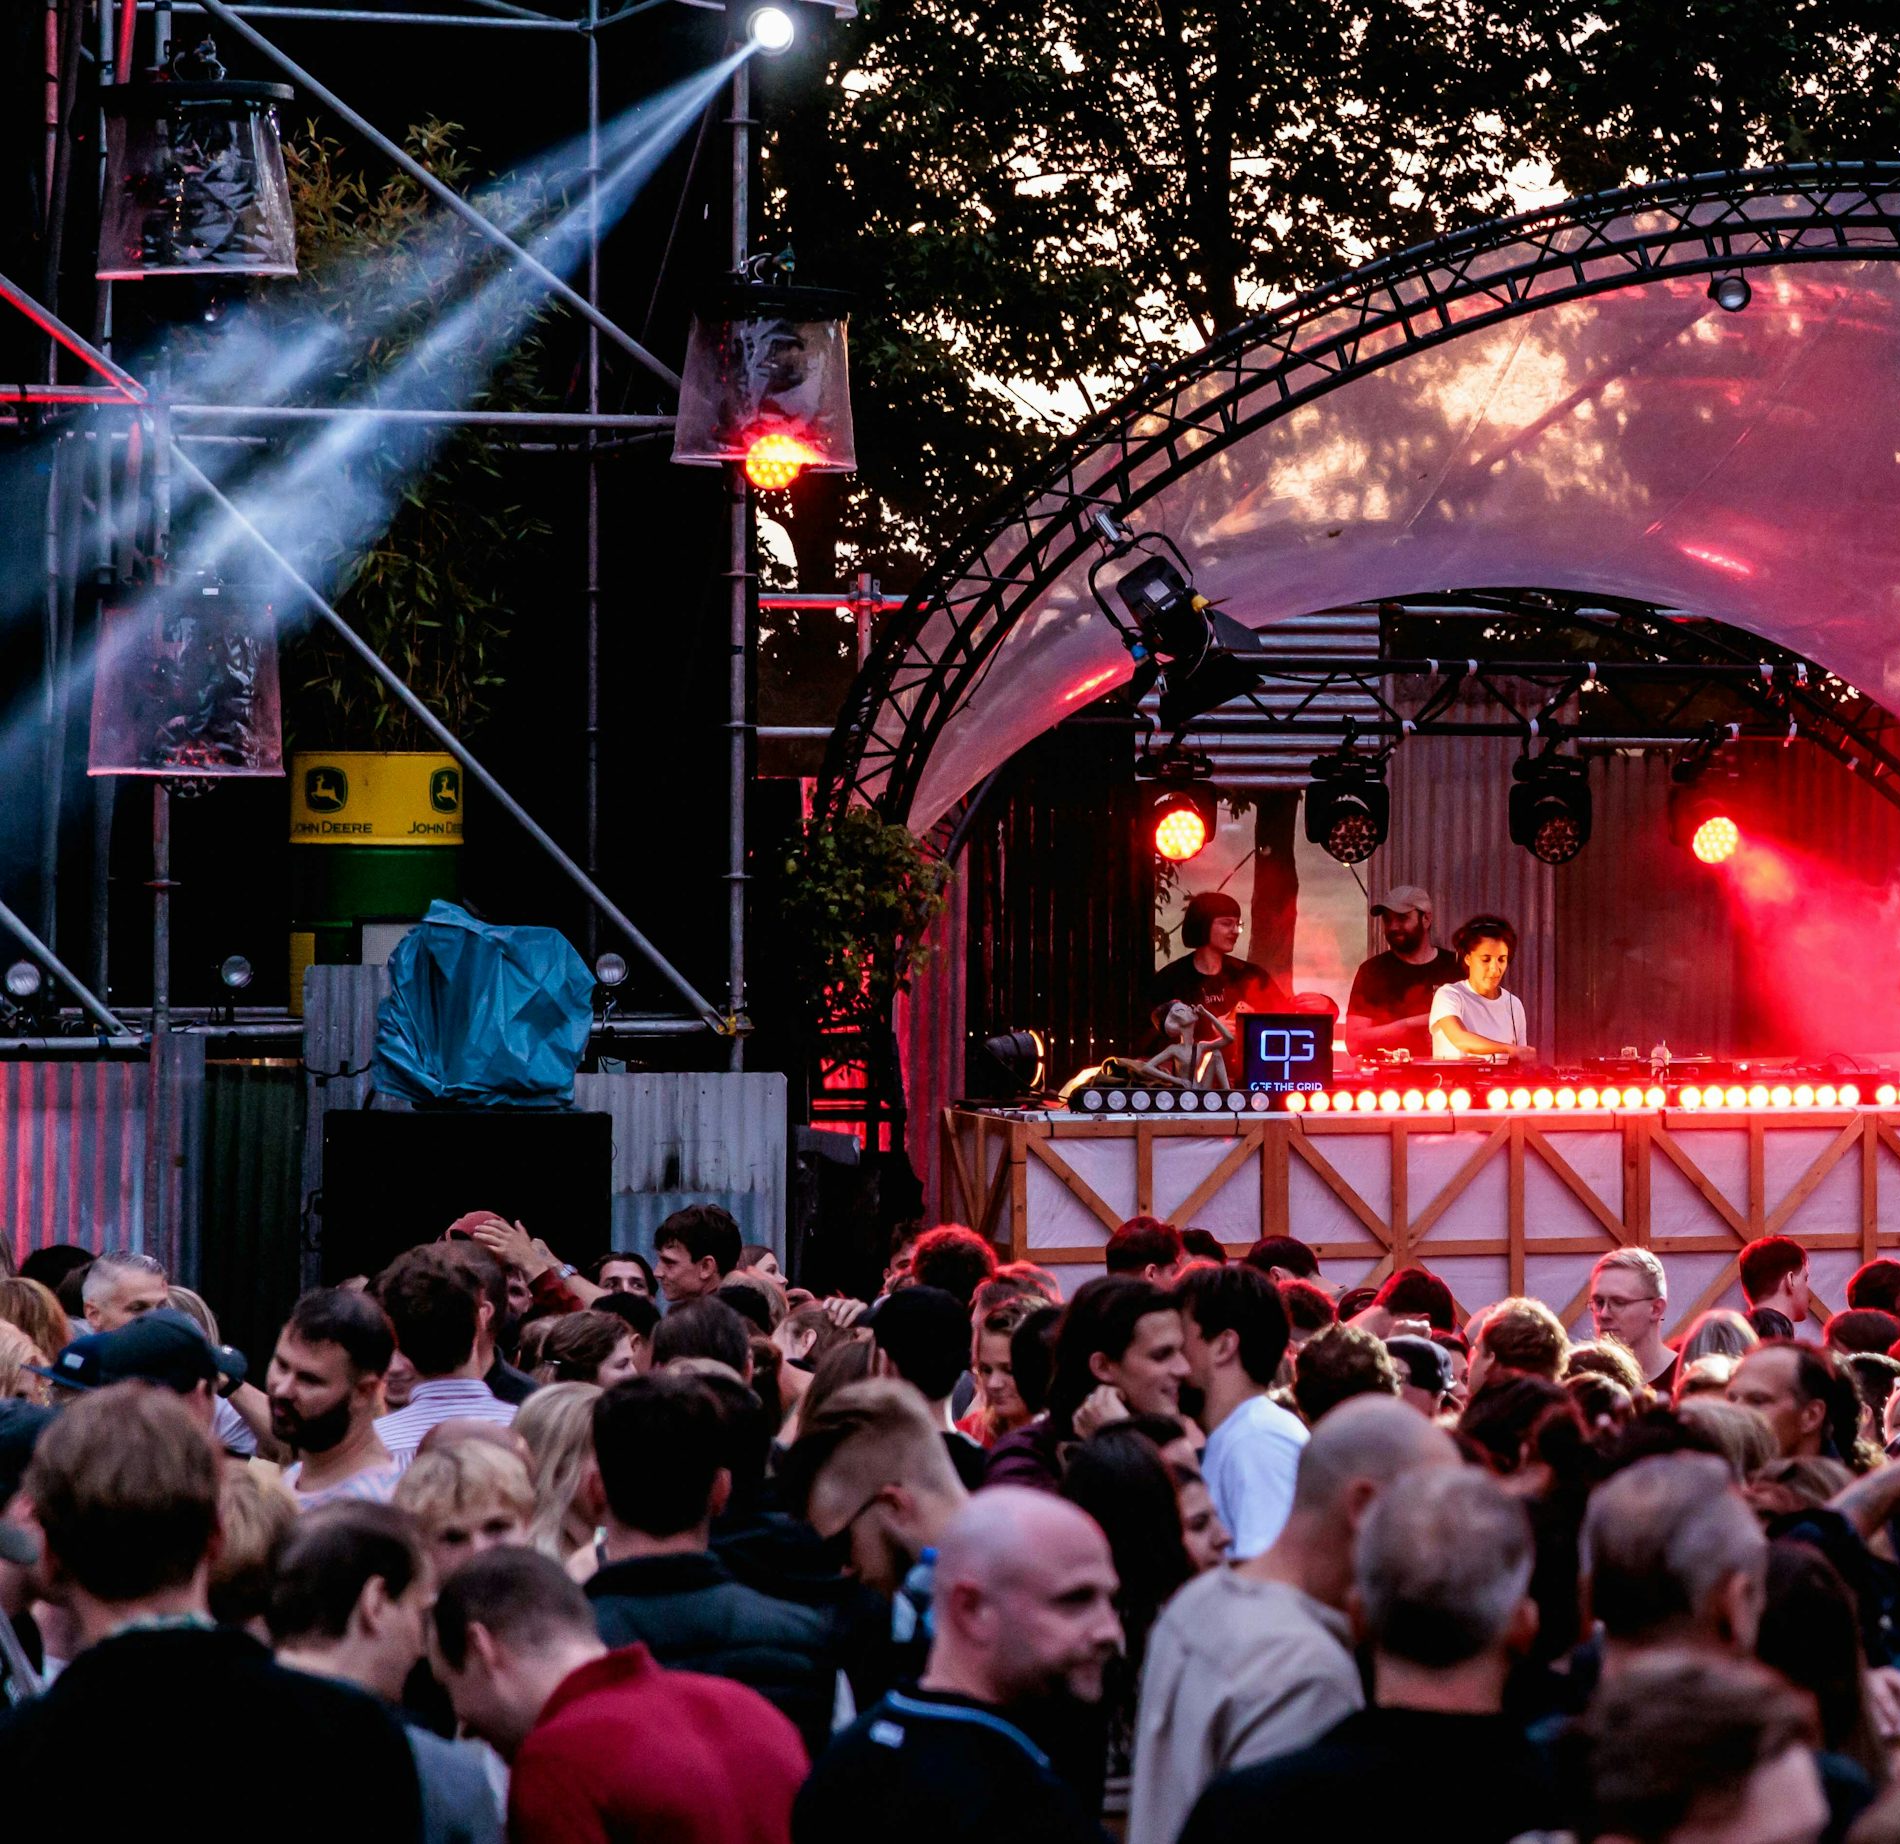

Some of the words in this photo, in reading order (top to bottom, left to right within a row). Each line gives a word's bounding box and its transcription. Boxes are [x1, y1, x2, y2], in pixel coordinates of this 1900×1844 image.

[321, 820, 373, 834] DEERE
[407, 821, 445, 834] JOHN
[1273, 1081, 1295, 1092] THE
[1296, 1081, 1323, 1092] GRID
